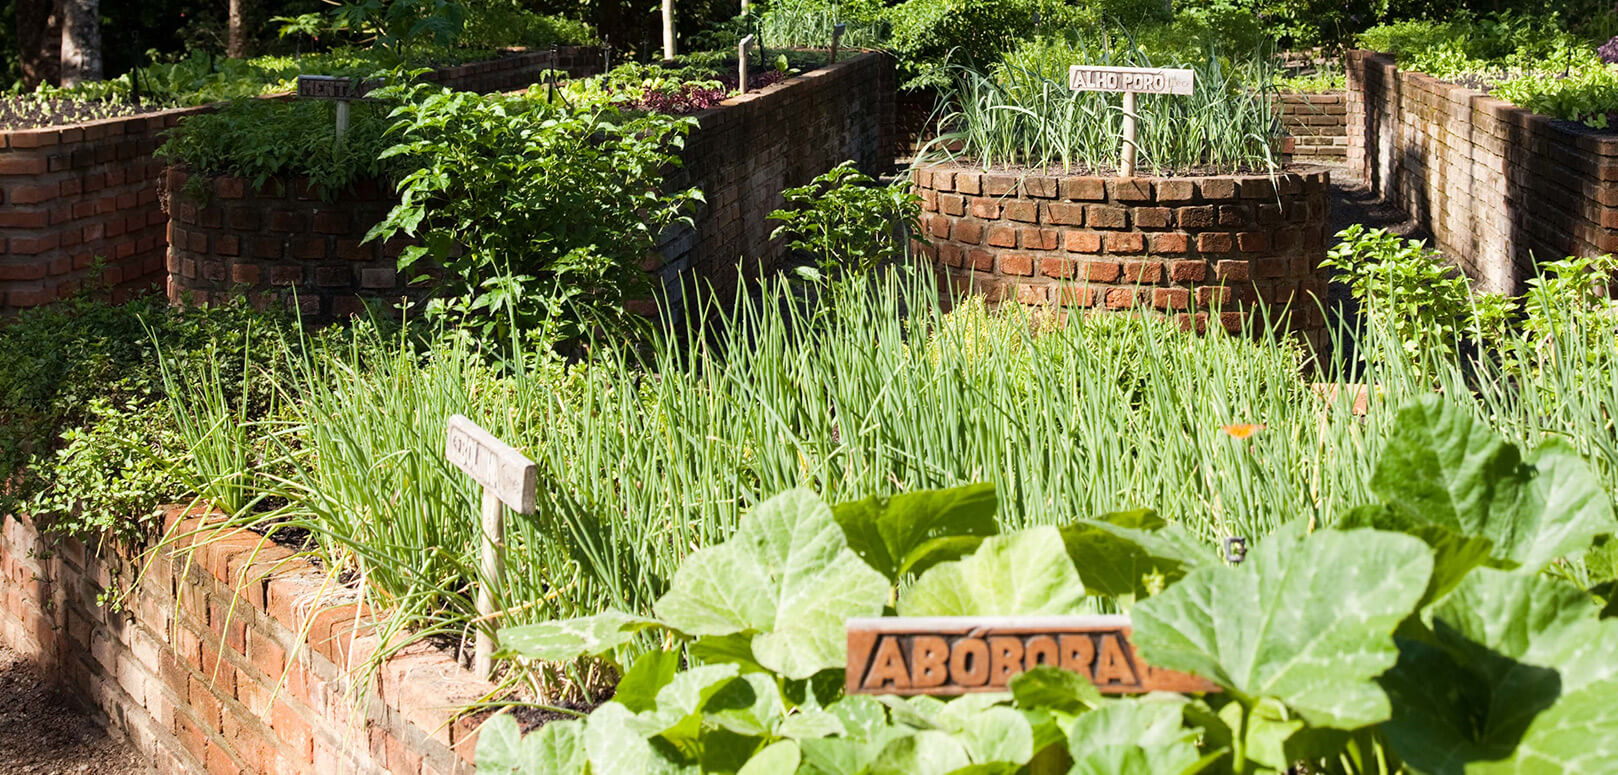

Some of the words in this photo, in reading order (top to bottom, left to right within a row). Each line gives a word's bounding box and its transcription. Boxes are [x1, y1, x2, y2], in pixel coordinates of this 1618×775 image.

[1074, 71, 1118, 89] ALHO
[1122, 71, 1165, 91] PORÓ
[861, 627, 1137, 688] ABÓBORA
